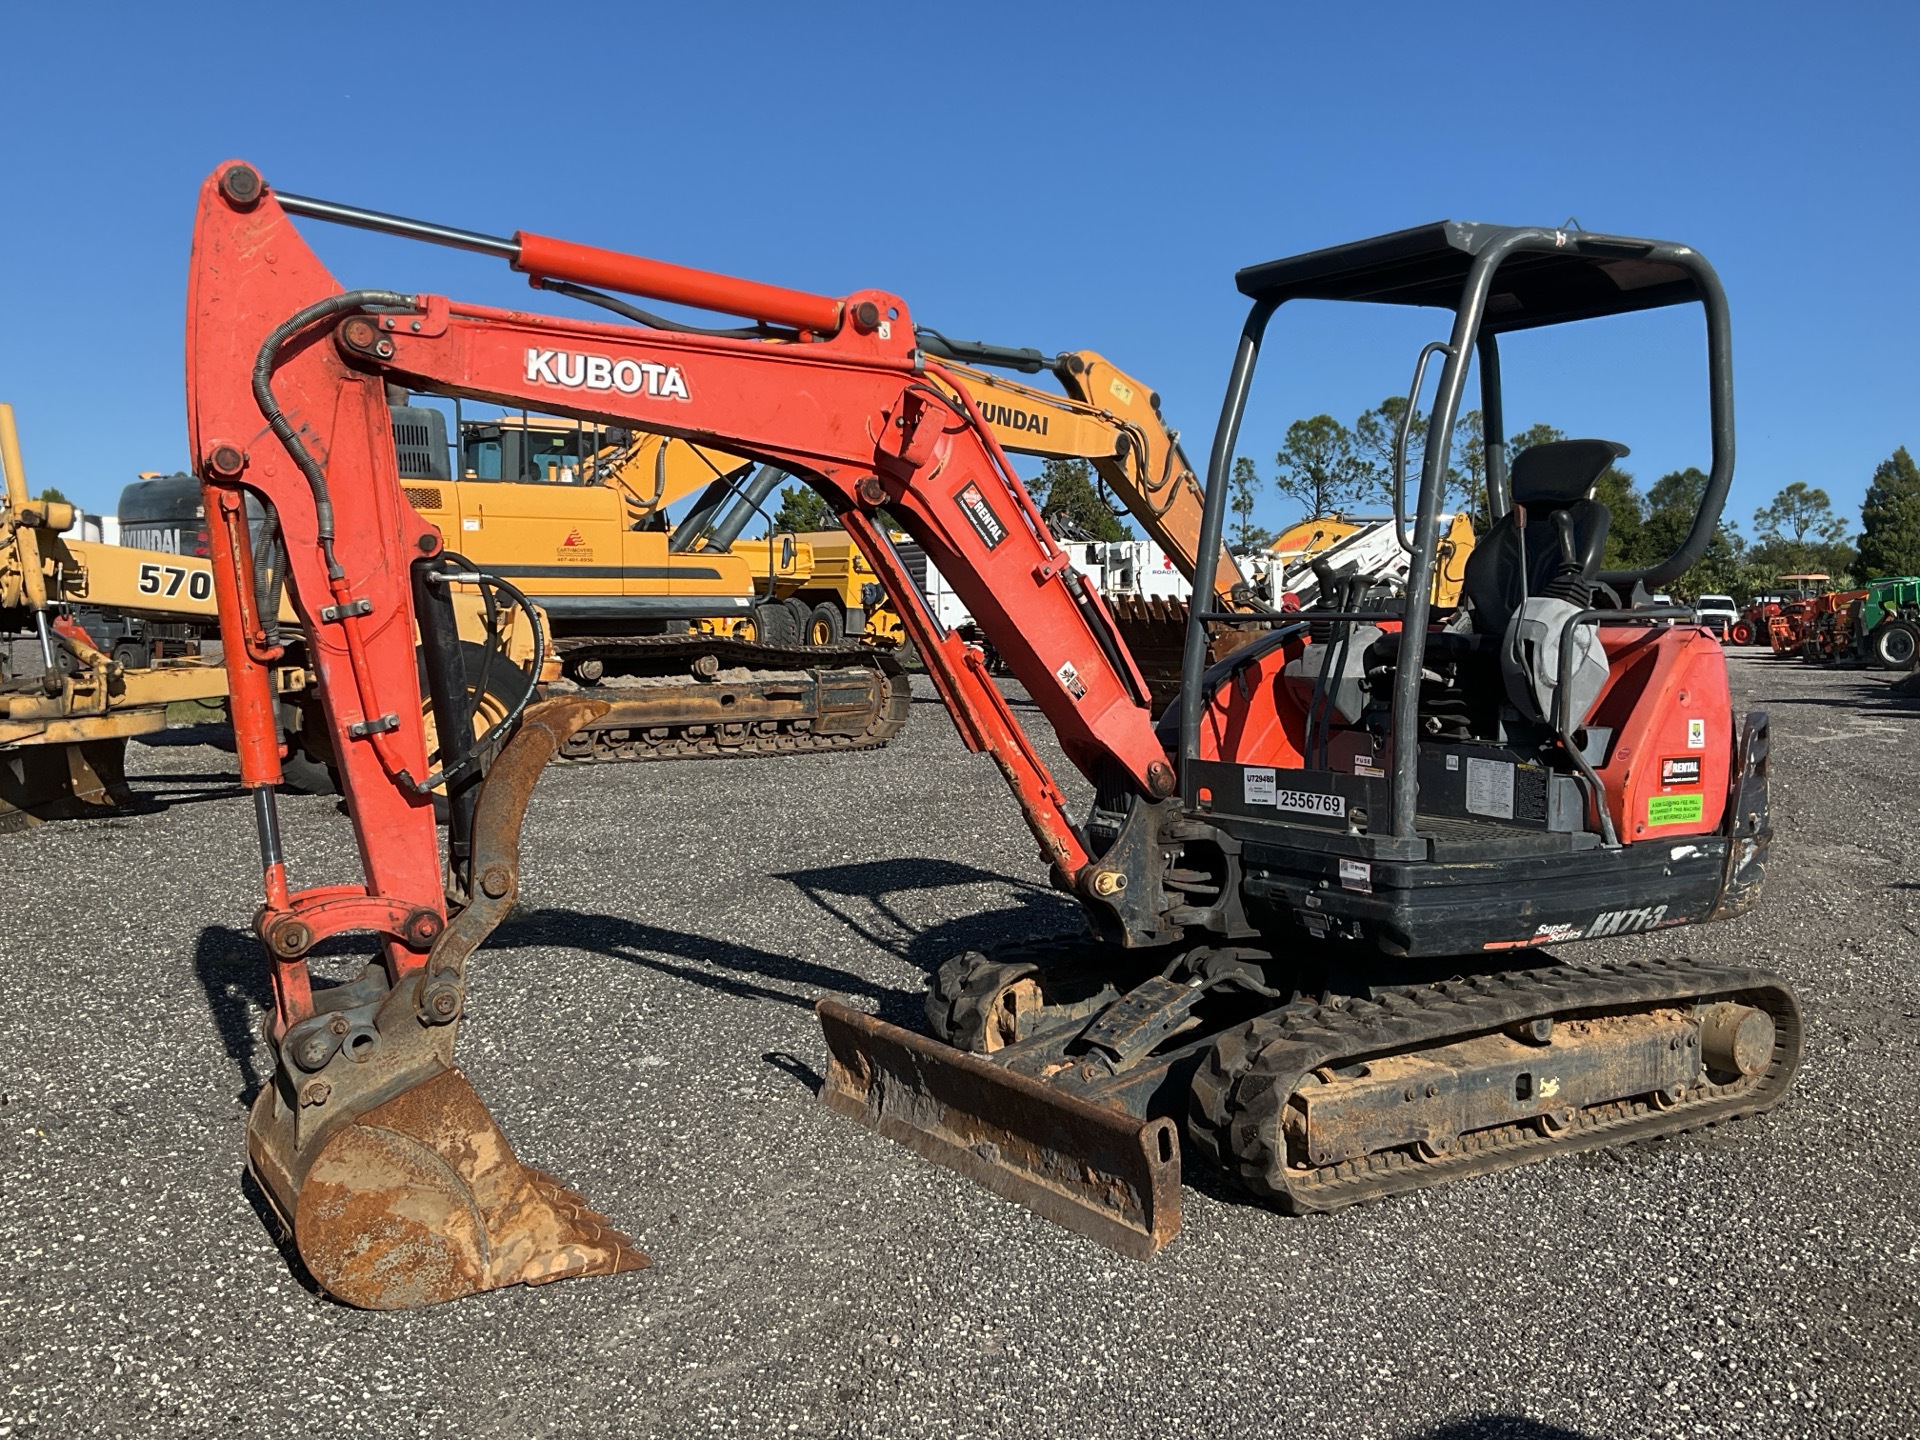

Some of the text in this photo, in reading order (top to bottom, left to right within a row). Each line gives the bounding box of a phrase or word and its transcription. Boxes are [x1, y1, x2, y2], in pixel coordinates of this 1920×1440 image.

[526, 348, 689, 399] KUBOTA
[973, 500, 1002, 542] RENTAL
[138, 562, 213, 601] 570
[1356, 757, 1371, 765] FUSE
[1673, 762, 1698, 773] RENTAL
[1281, 791, 1340, 812] 2556769
[1535, 923, 1572, 935] Super
[1584, 904, 1669, 938] KX71-3
[1547, 929, 1583, 942] Series
